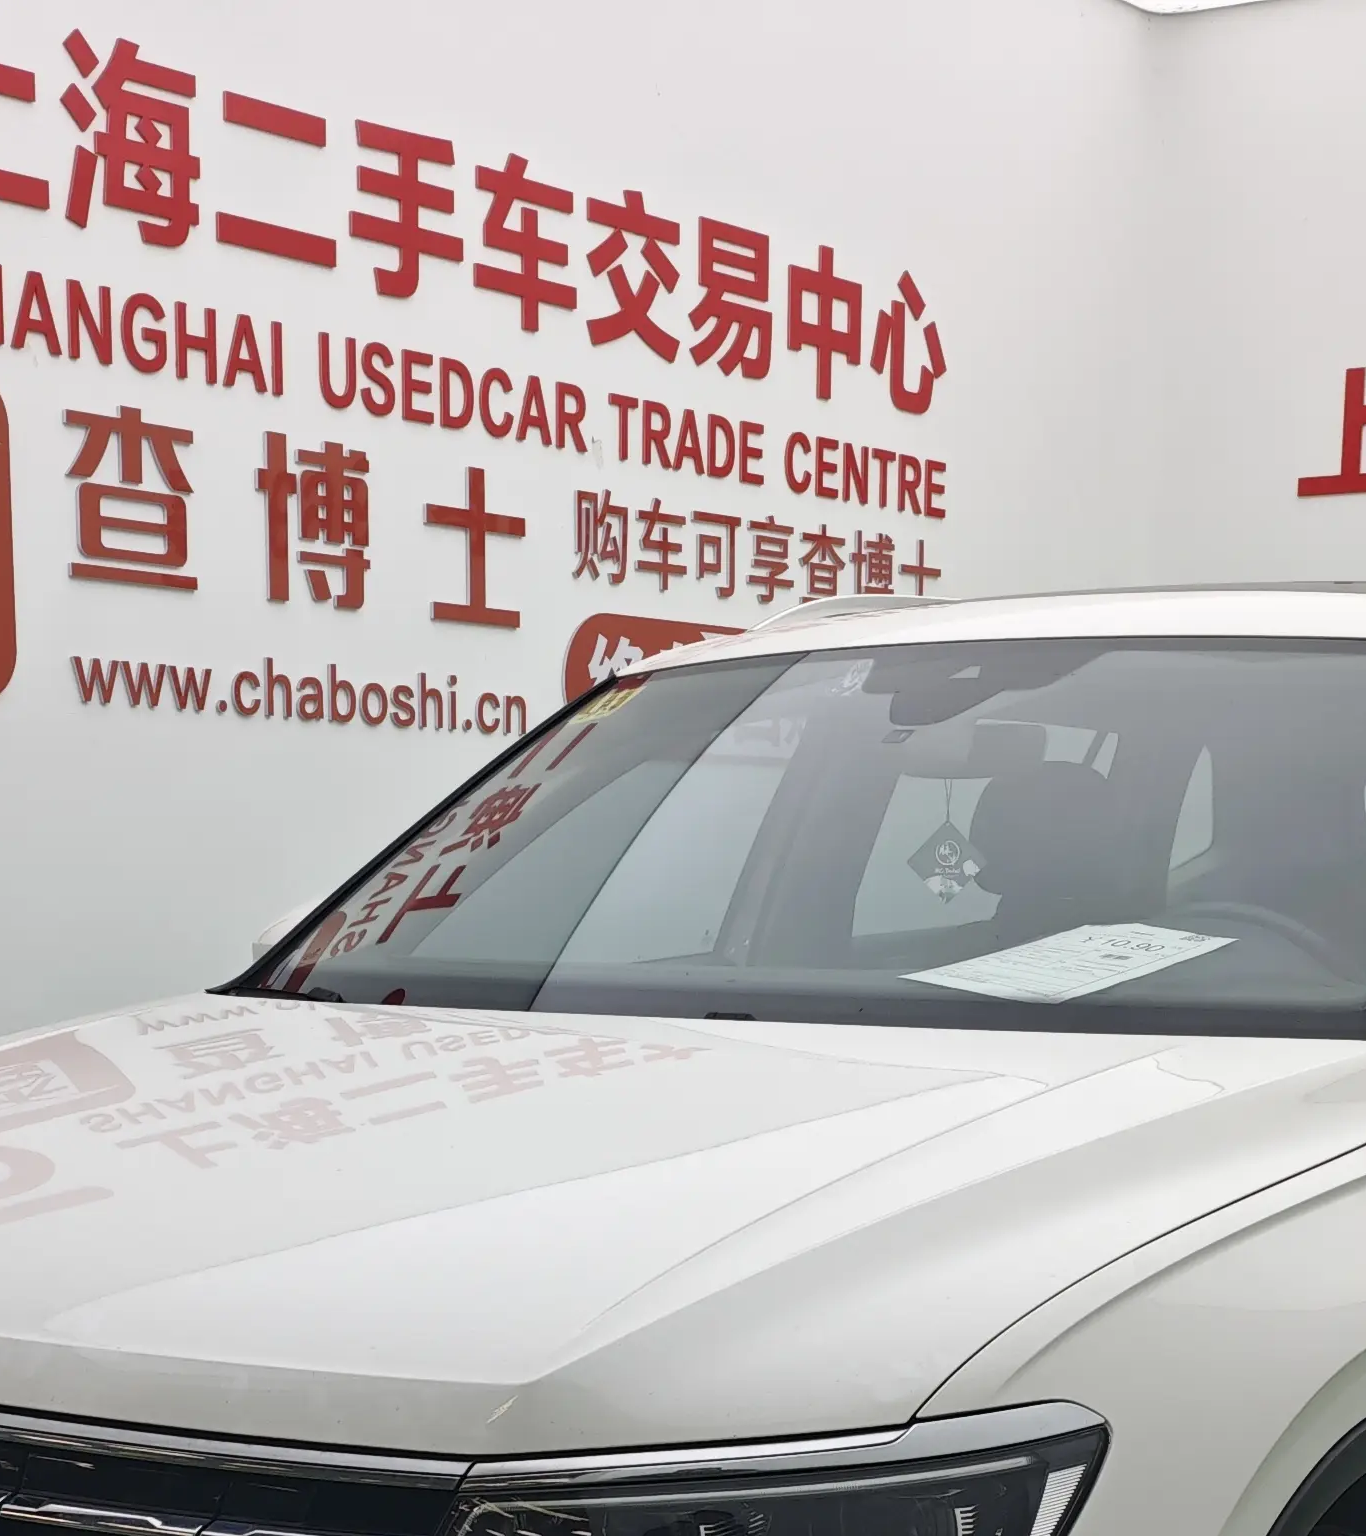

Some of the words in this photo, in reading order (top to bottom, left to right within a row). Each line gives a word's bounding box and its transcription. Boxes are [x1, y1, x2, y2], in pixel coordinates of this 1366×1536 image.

[319, 332, 588, 453] USEDCAR
[609, 393, 765, 486] TRADE
[784, 431, 947, 520] CENTRE
[63, 406, 527, 629] 查博士
[572, 489, 942, 604] 购车可享查博士
[71, 655, 530, 735] www.chaboshi.cn
